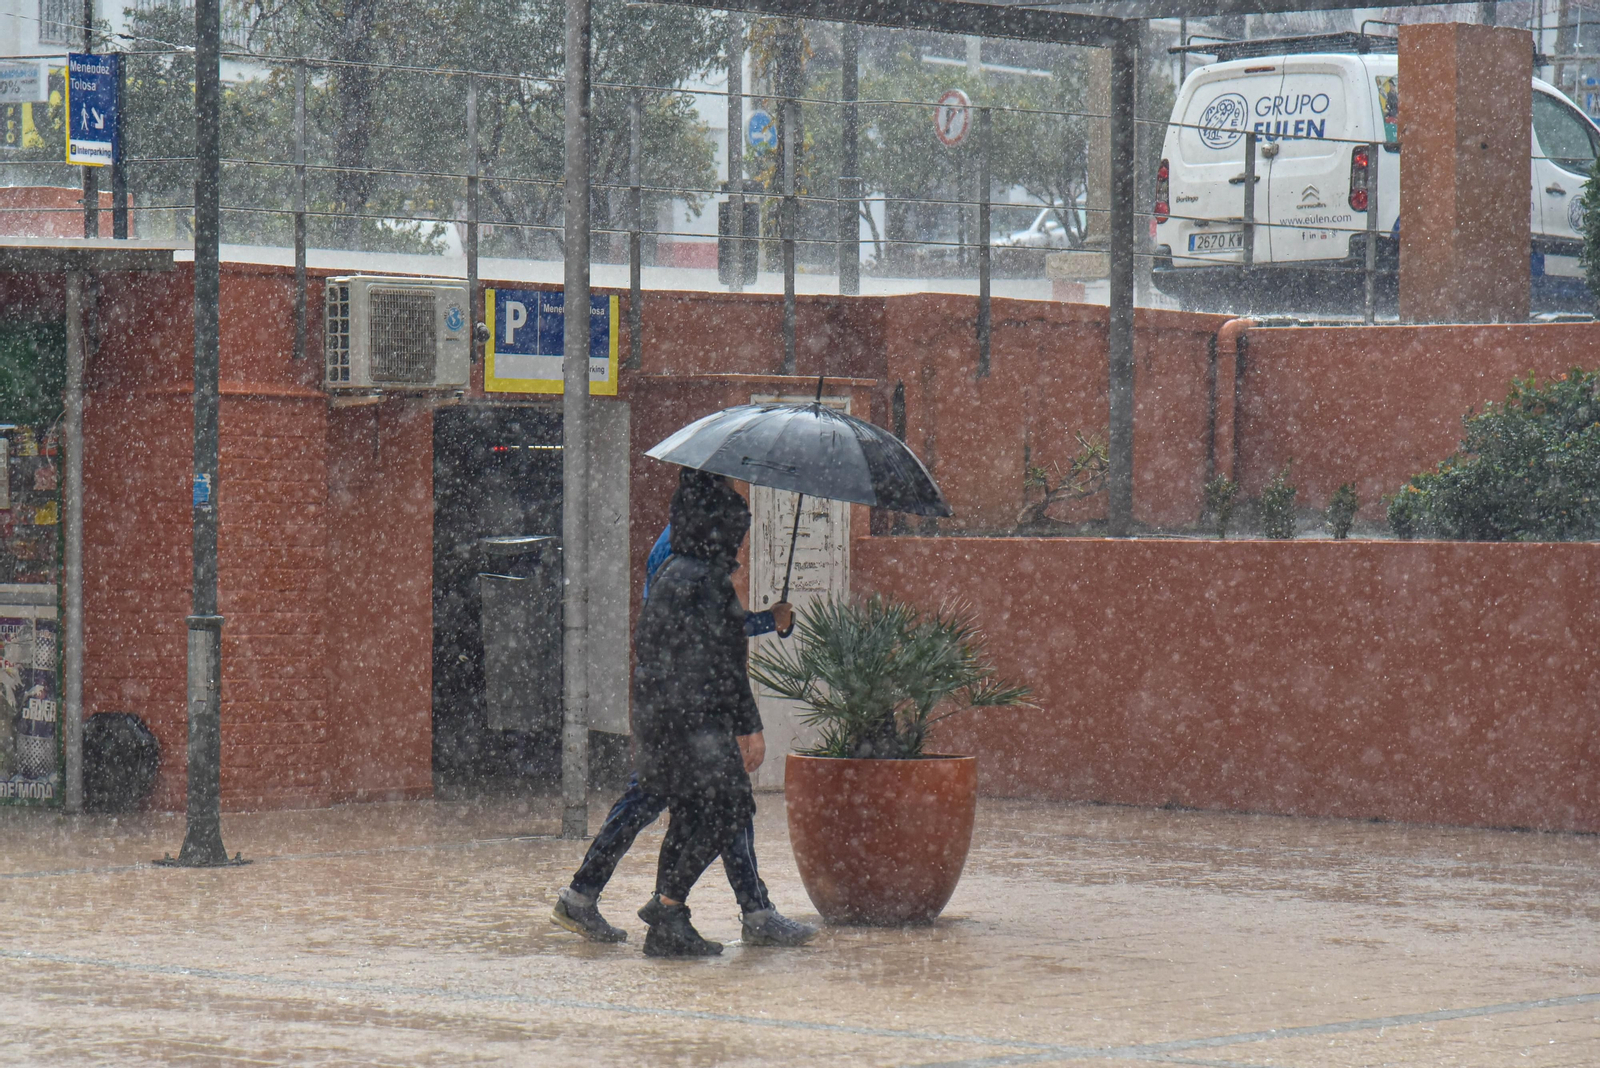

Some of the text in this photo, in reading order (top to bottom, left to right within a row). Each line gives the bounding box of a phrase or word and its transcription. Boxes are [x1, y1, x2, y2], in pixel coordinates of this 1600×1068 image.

[70, 59, 110, 75] Menéndez
[70, 77, 97, 91] Tolosa
[1255, 92, 1330, 117] GRUPO
[1254, 118, 1326, 142] EULEN
[77, 146, 112, 159] Interparking
[1279, 214, 1352, 226] www.eulen.com
[1197, 234, 1226, 249] 2670
[589, 305, 605, 315] losa
[505, 300, 527, 344] P
[29, 697, 57, 711] ENER
